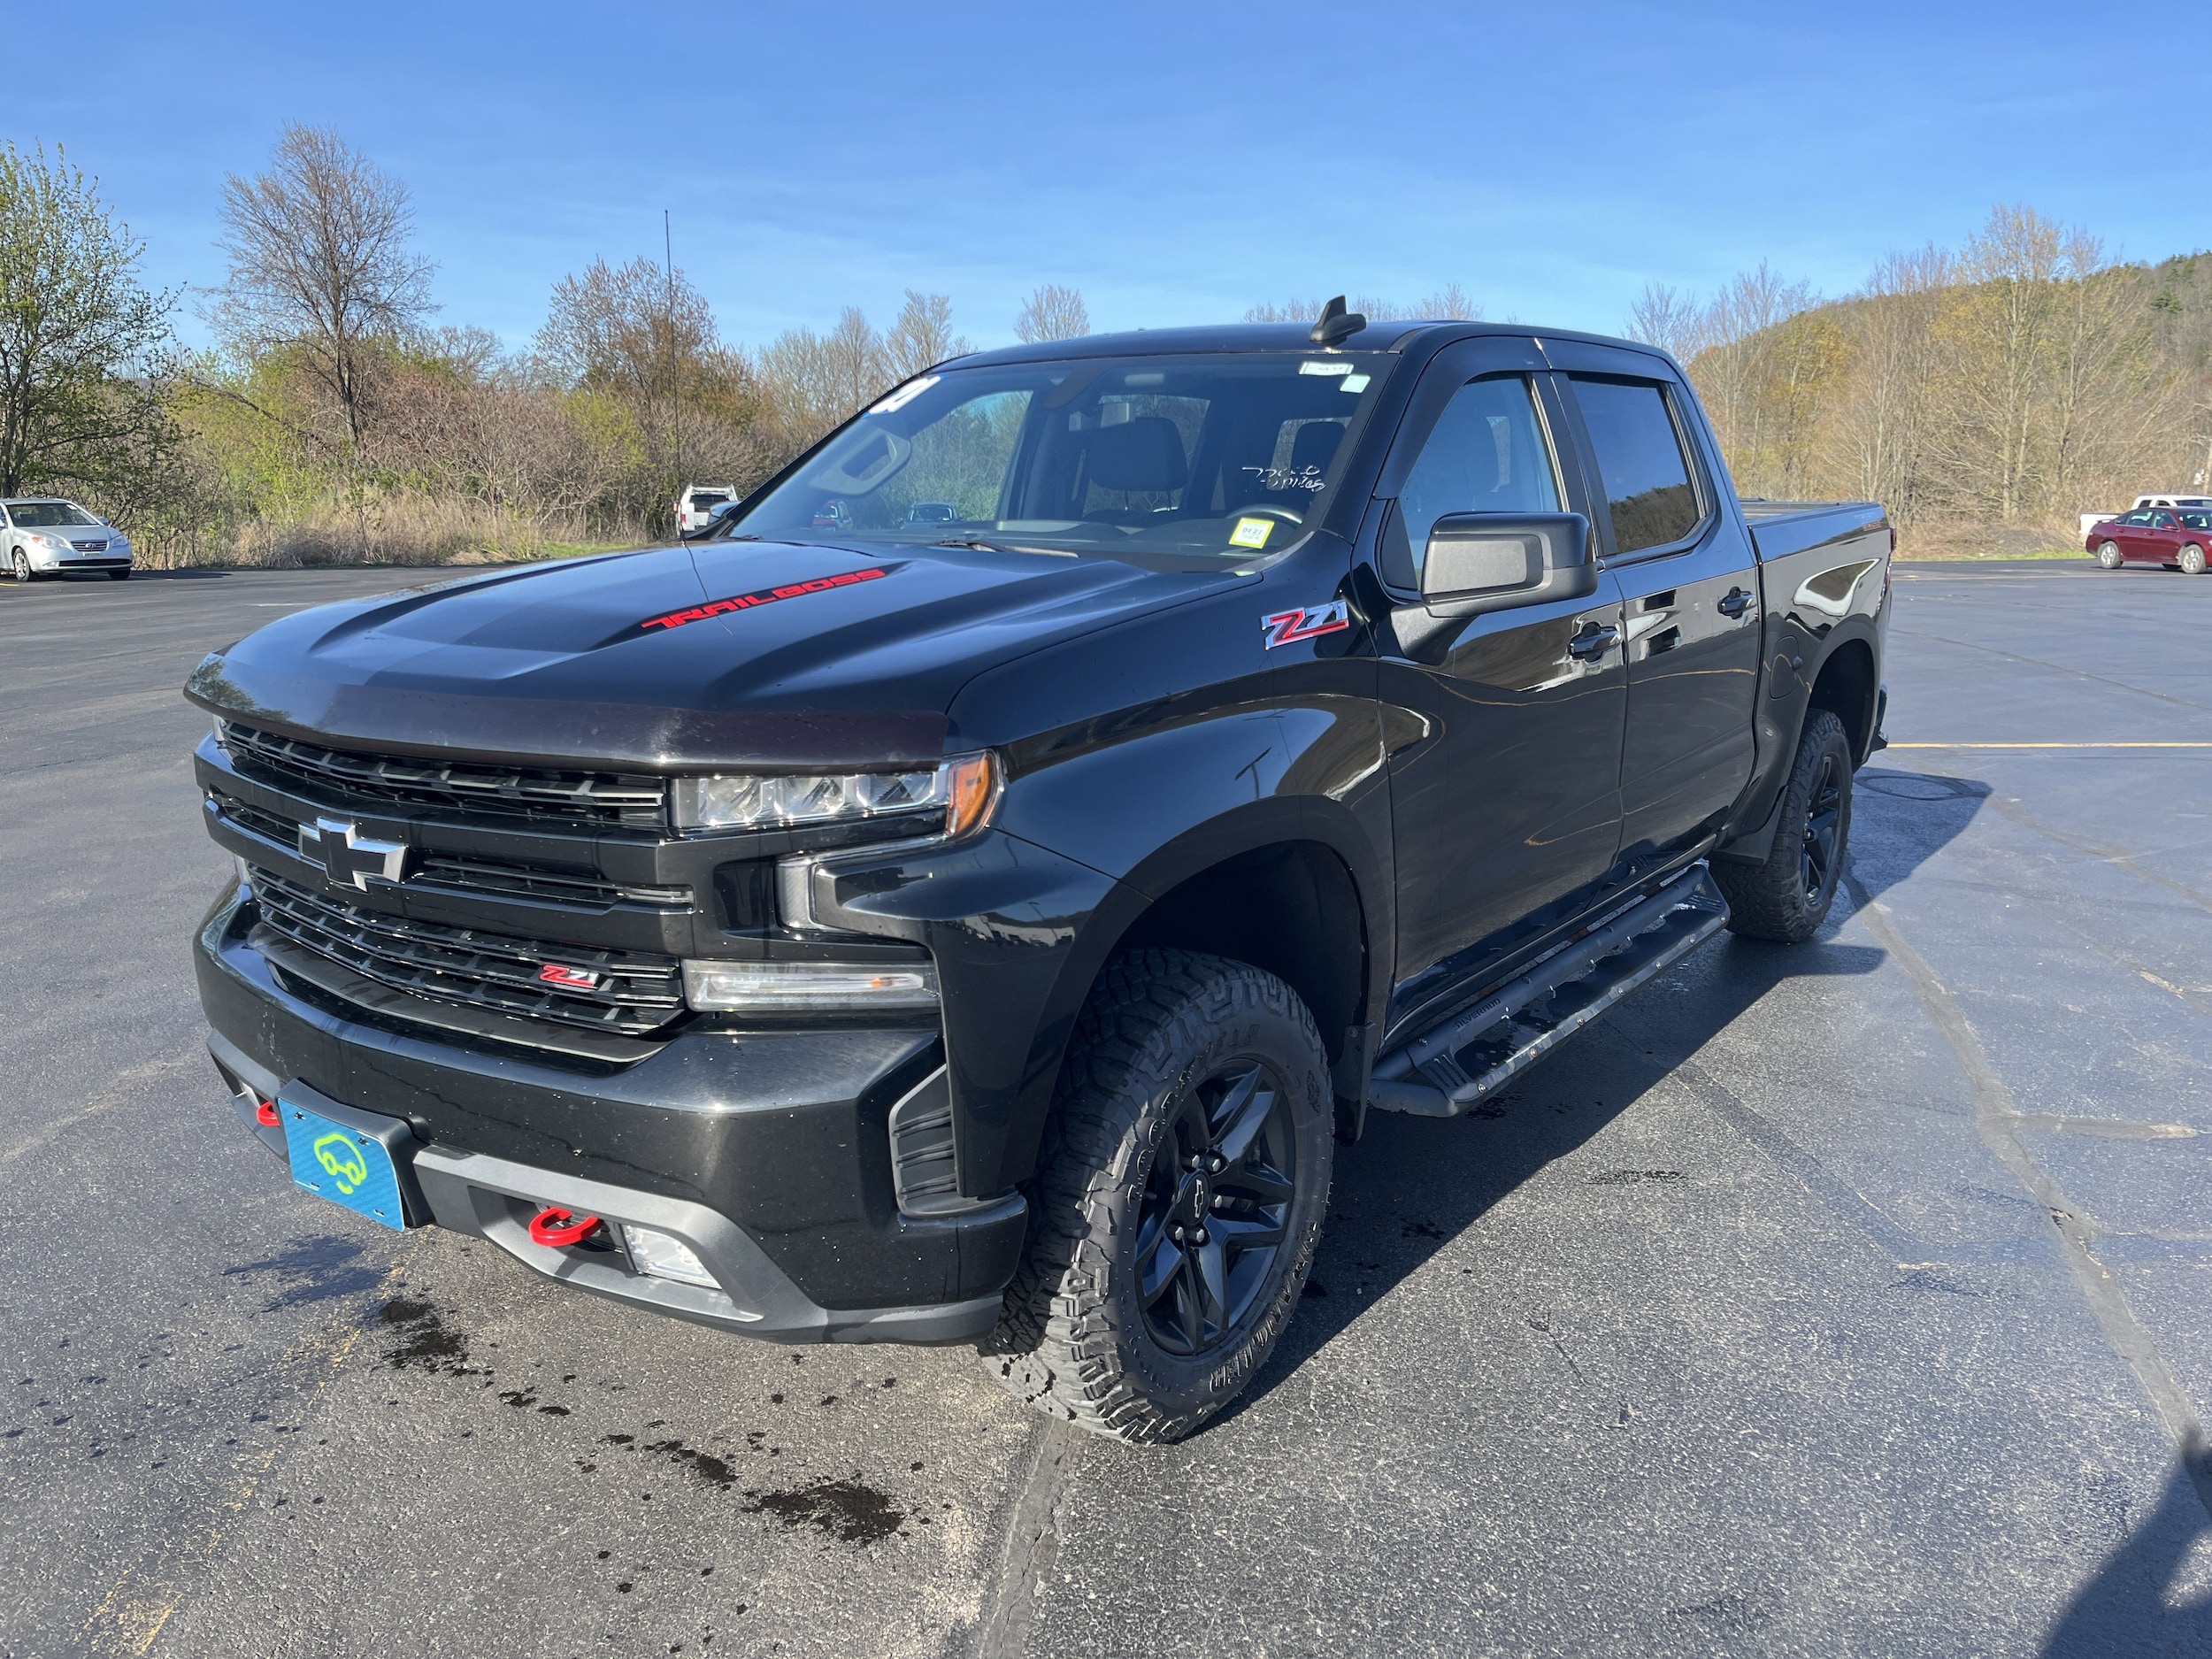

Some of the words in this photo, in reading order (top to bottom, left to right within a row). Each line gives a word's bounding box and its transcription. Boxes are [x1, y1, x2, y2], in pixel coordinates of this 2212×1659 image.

[1261, 599, 1348, 650] Z71
[540, 964, 599, 988] Z71
[1453, 998, 1502, 1028] SILVERADO
